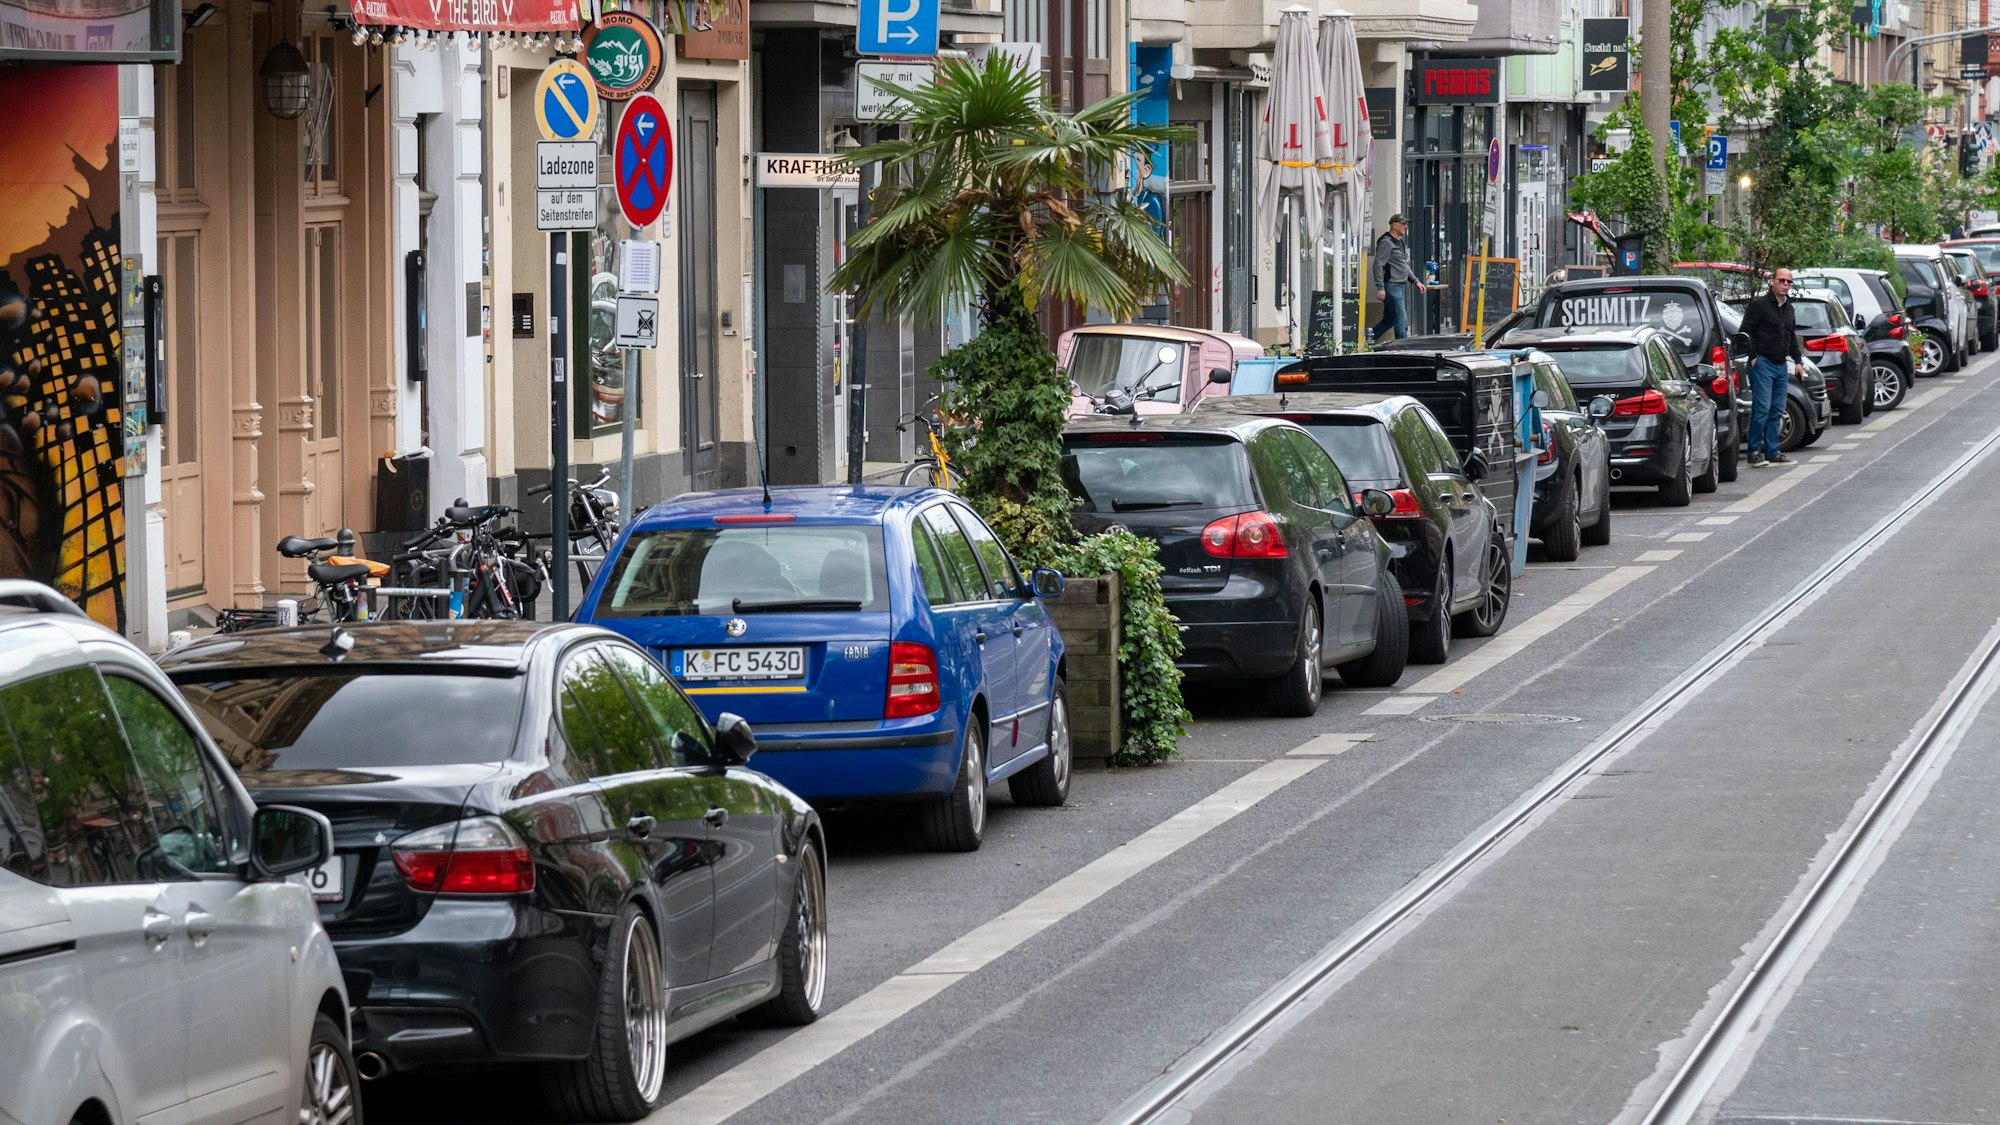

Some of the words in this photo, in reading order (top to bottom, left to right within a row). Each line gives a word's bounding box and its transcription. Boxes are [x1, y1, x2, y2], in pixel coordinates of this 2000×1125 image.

[448, 0, 470, 24] THE
[472, 0, 498, 25] BIRD
[603, 16, 633, 25] MOMO
[877, 0, 920, 43] P
[1584, 42, 1611, 52] Sushi
[880, 71, 894, 81] nur
[898, 71, 913, 81] mit
[1424, 69, 1490, 96] remos
[540, 155, 594, 175] Ladezone
[551, 190, 563, 204] auf
[567, 191, 583, 204] dem
[540, 207, 593, 221] Seitenstreifen
[1561, 295, 1651, 326] SCHMITZ
[844, 646, 869, 659] FABIA
[685, 652, 699, 673] K
[714, 651, 741, 672] FC
[747, 651, 800, 672] 5430
